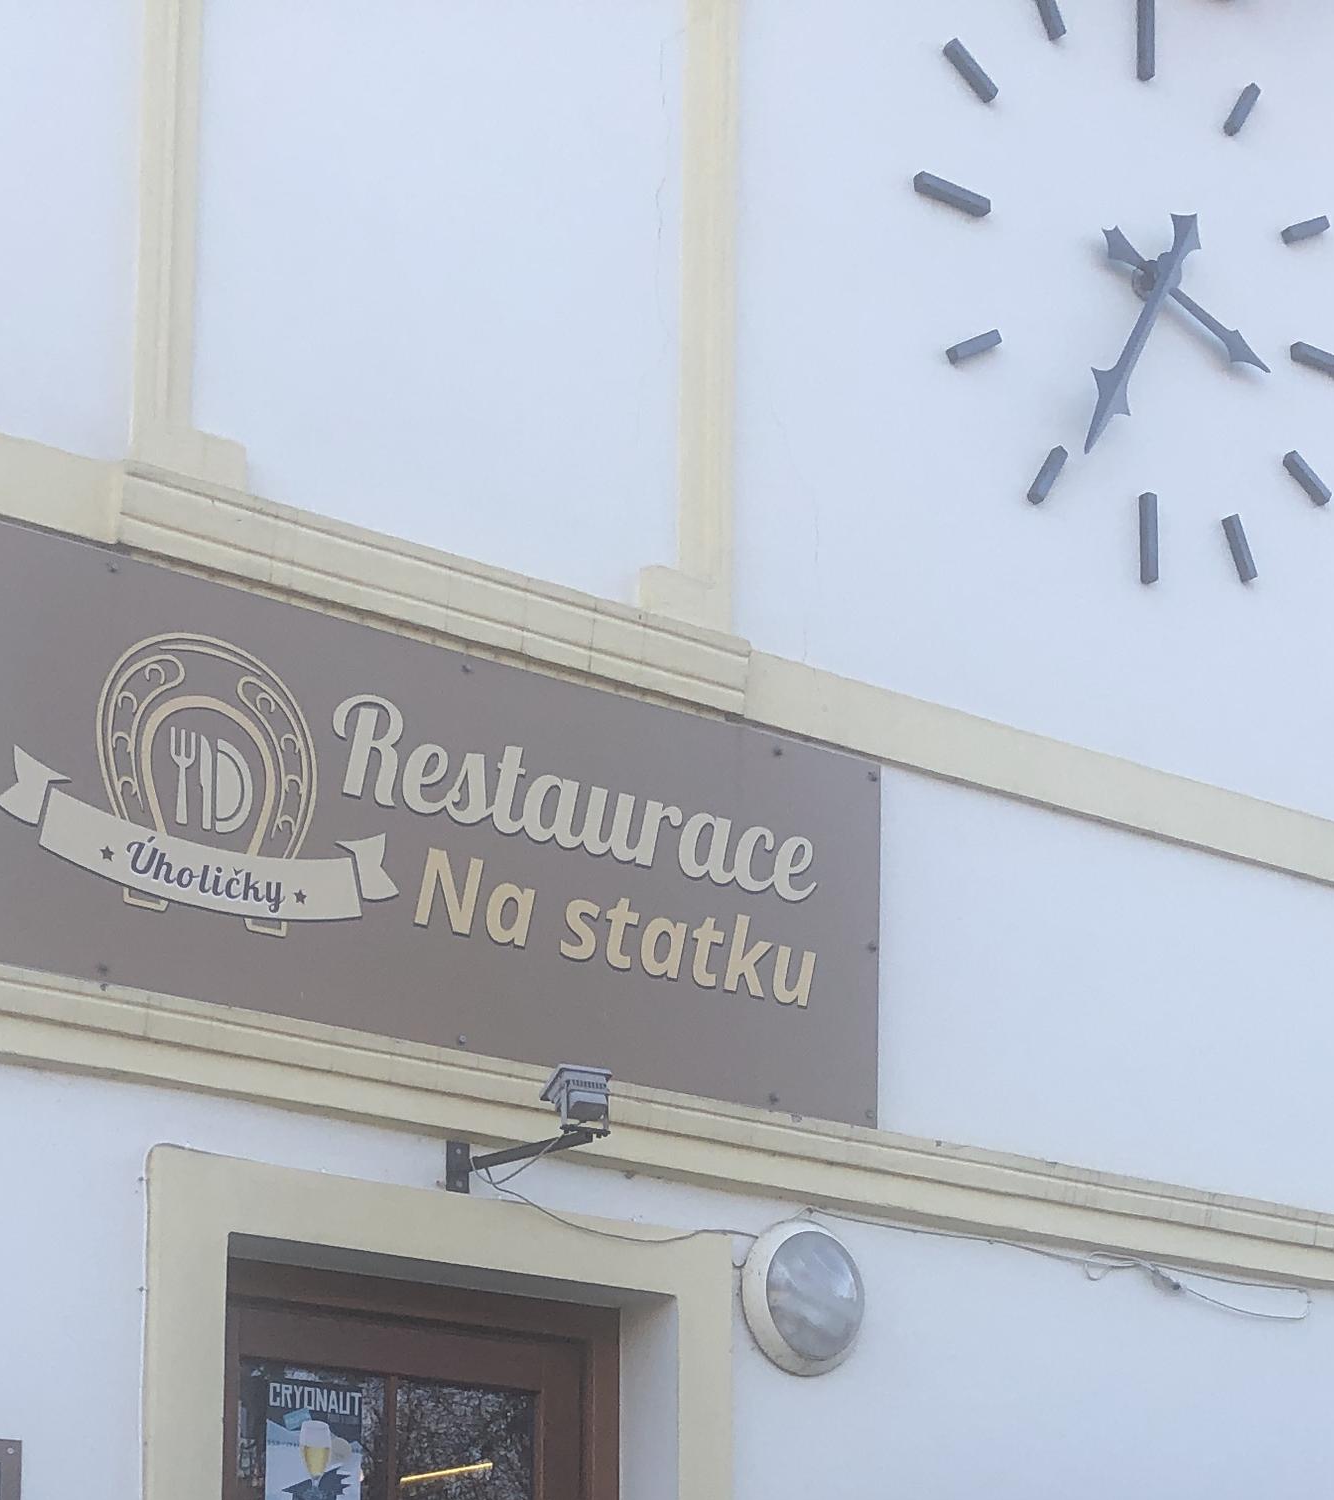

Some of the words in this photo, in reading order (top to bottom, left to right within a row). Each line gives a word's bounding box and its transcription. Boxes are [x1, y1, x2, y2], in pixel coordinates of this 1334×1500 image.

[331, 692, 818, 905] Restaurace
[127, 832, 286, 913] Úholičky
[412, 845, 537, 949] Na
[557, 890, 819, 1012] statku
[269, 1381, 362, 1416] CRYONAUT
